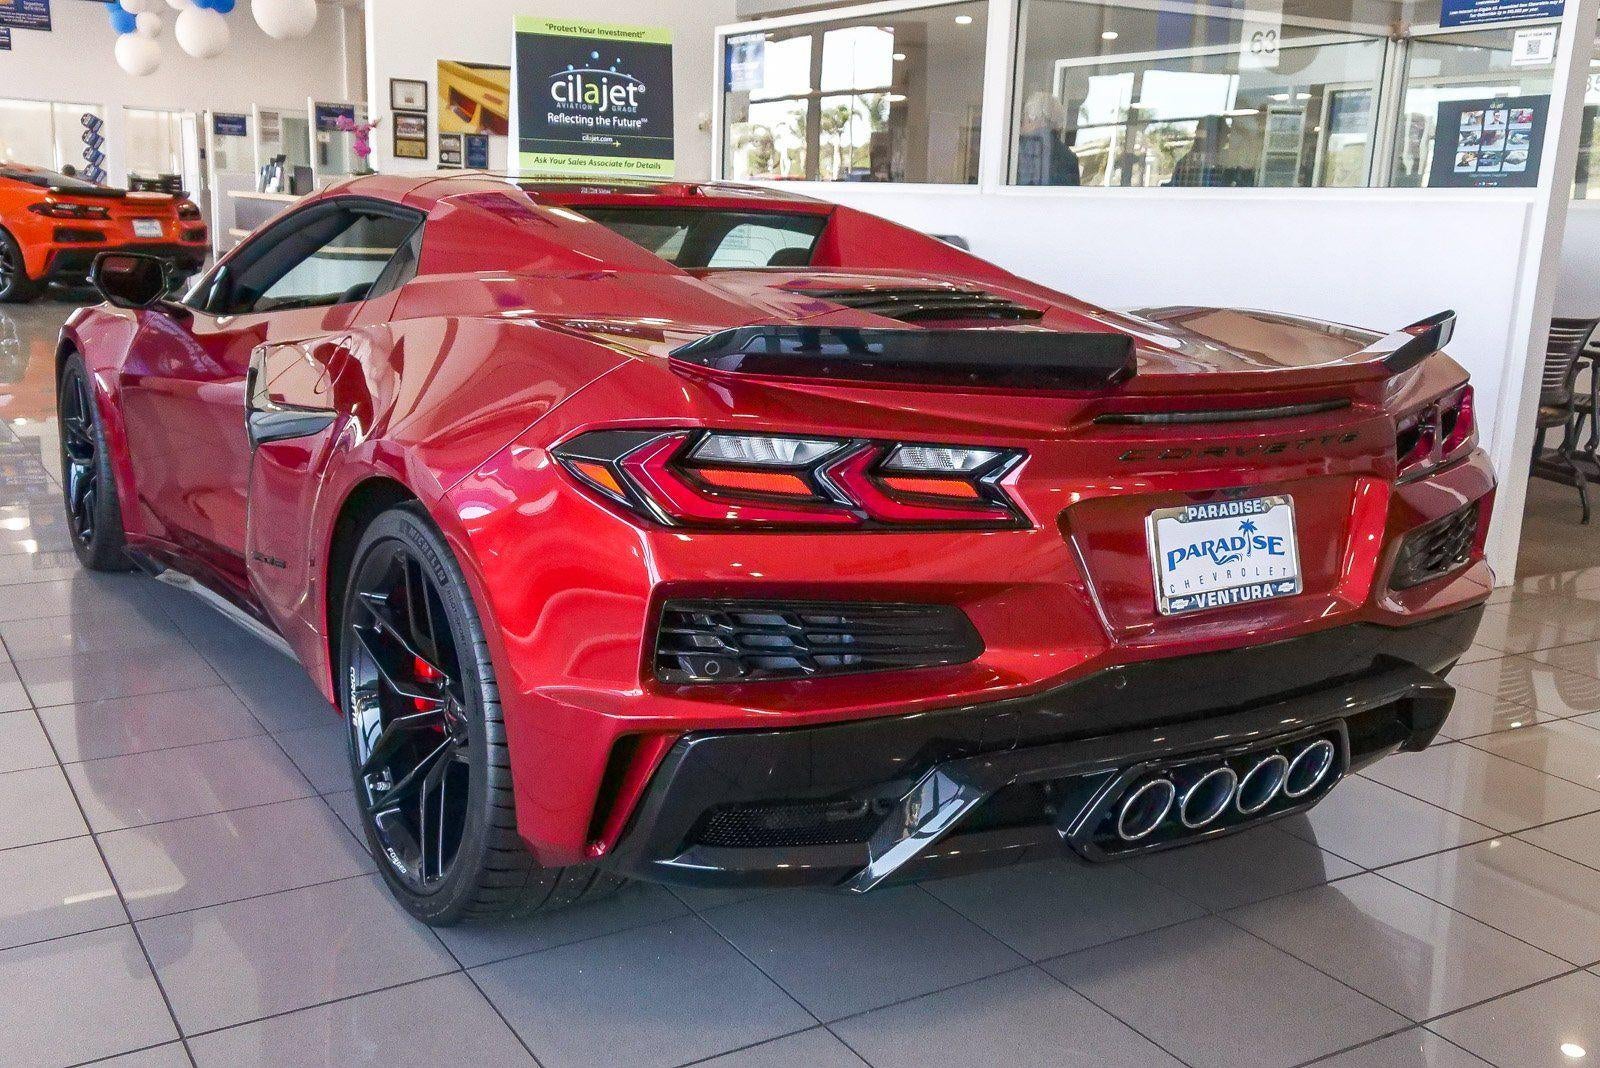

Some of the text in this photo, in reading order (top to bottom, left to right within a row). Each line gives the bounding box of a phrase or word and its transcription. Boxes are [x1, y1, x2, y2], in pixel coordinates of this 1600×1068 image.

[578, 26, 596, 34] Your
[556, 102, 637, 113] AVIATION GRADE
[547, 112, 594, 127] Reflecting
[595, 115, 611, 125] the
[534, 156, 661, 170] Ask Your Sales Associate for Details
[1188, 499, 1263, 520] PARADISE
[408, 526, 447, 582] MICHELIN
[1167, 520, 1286, 571] PARADISE
[1170, 567, 1287, 595] CHEVROLET
[1195, 583, 1275, 608] VENTURA
